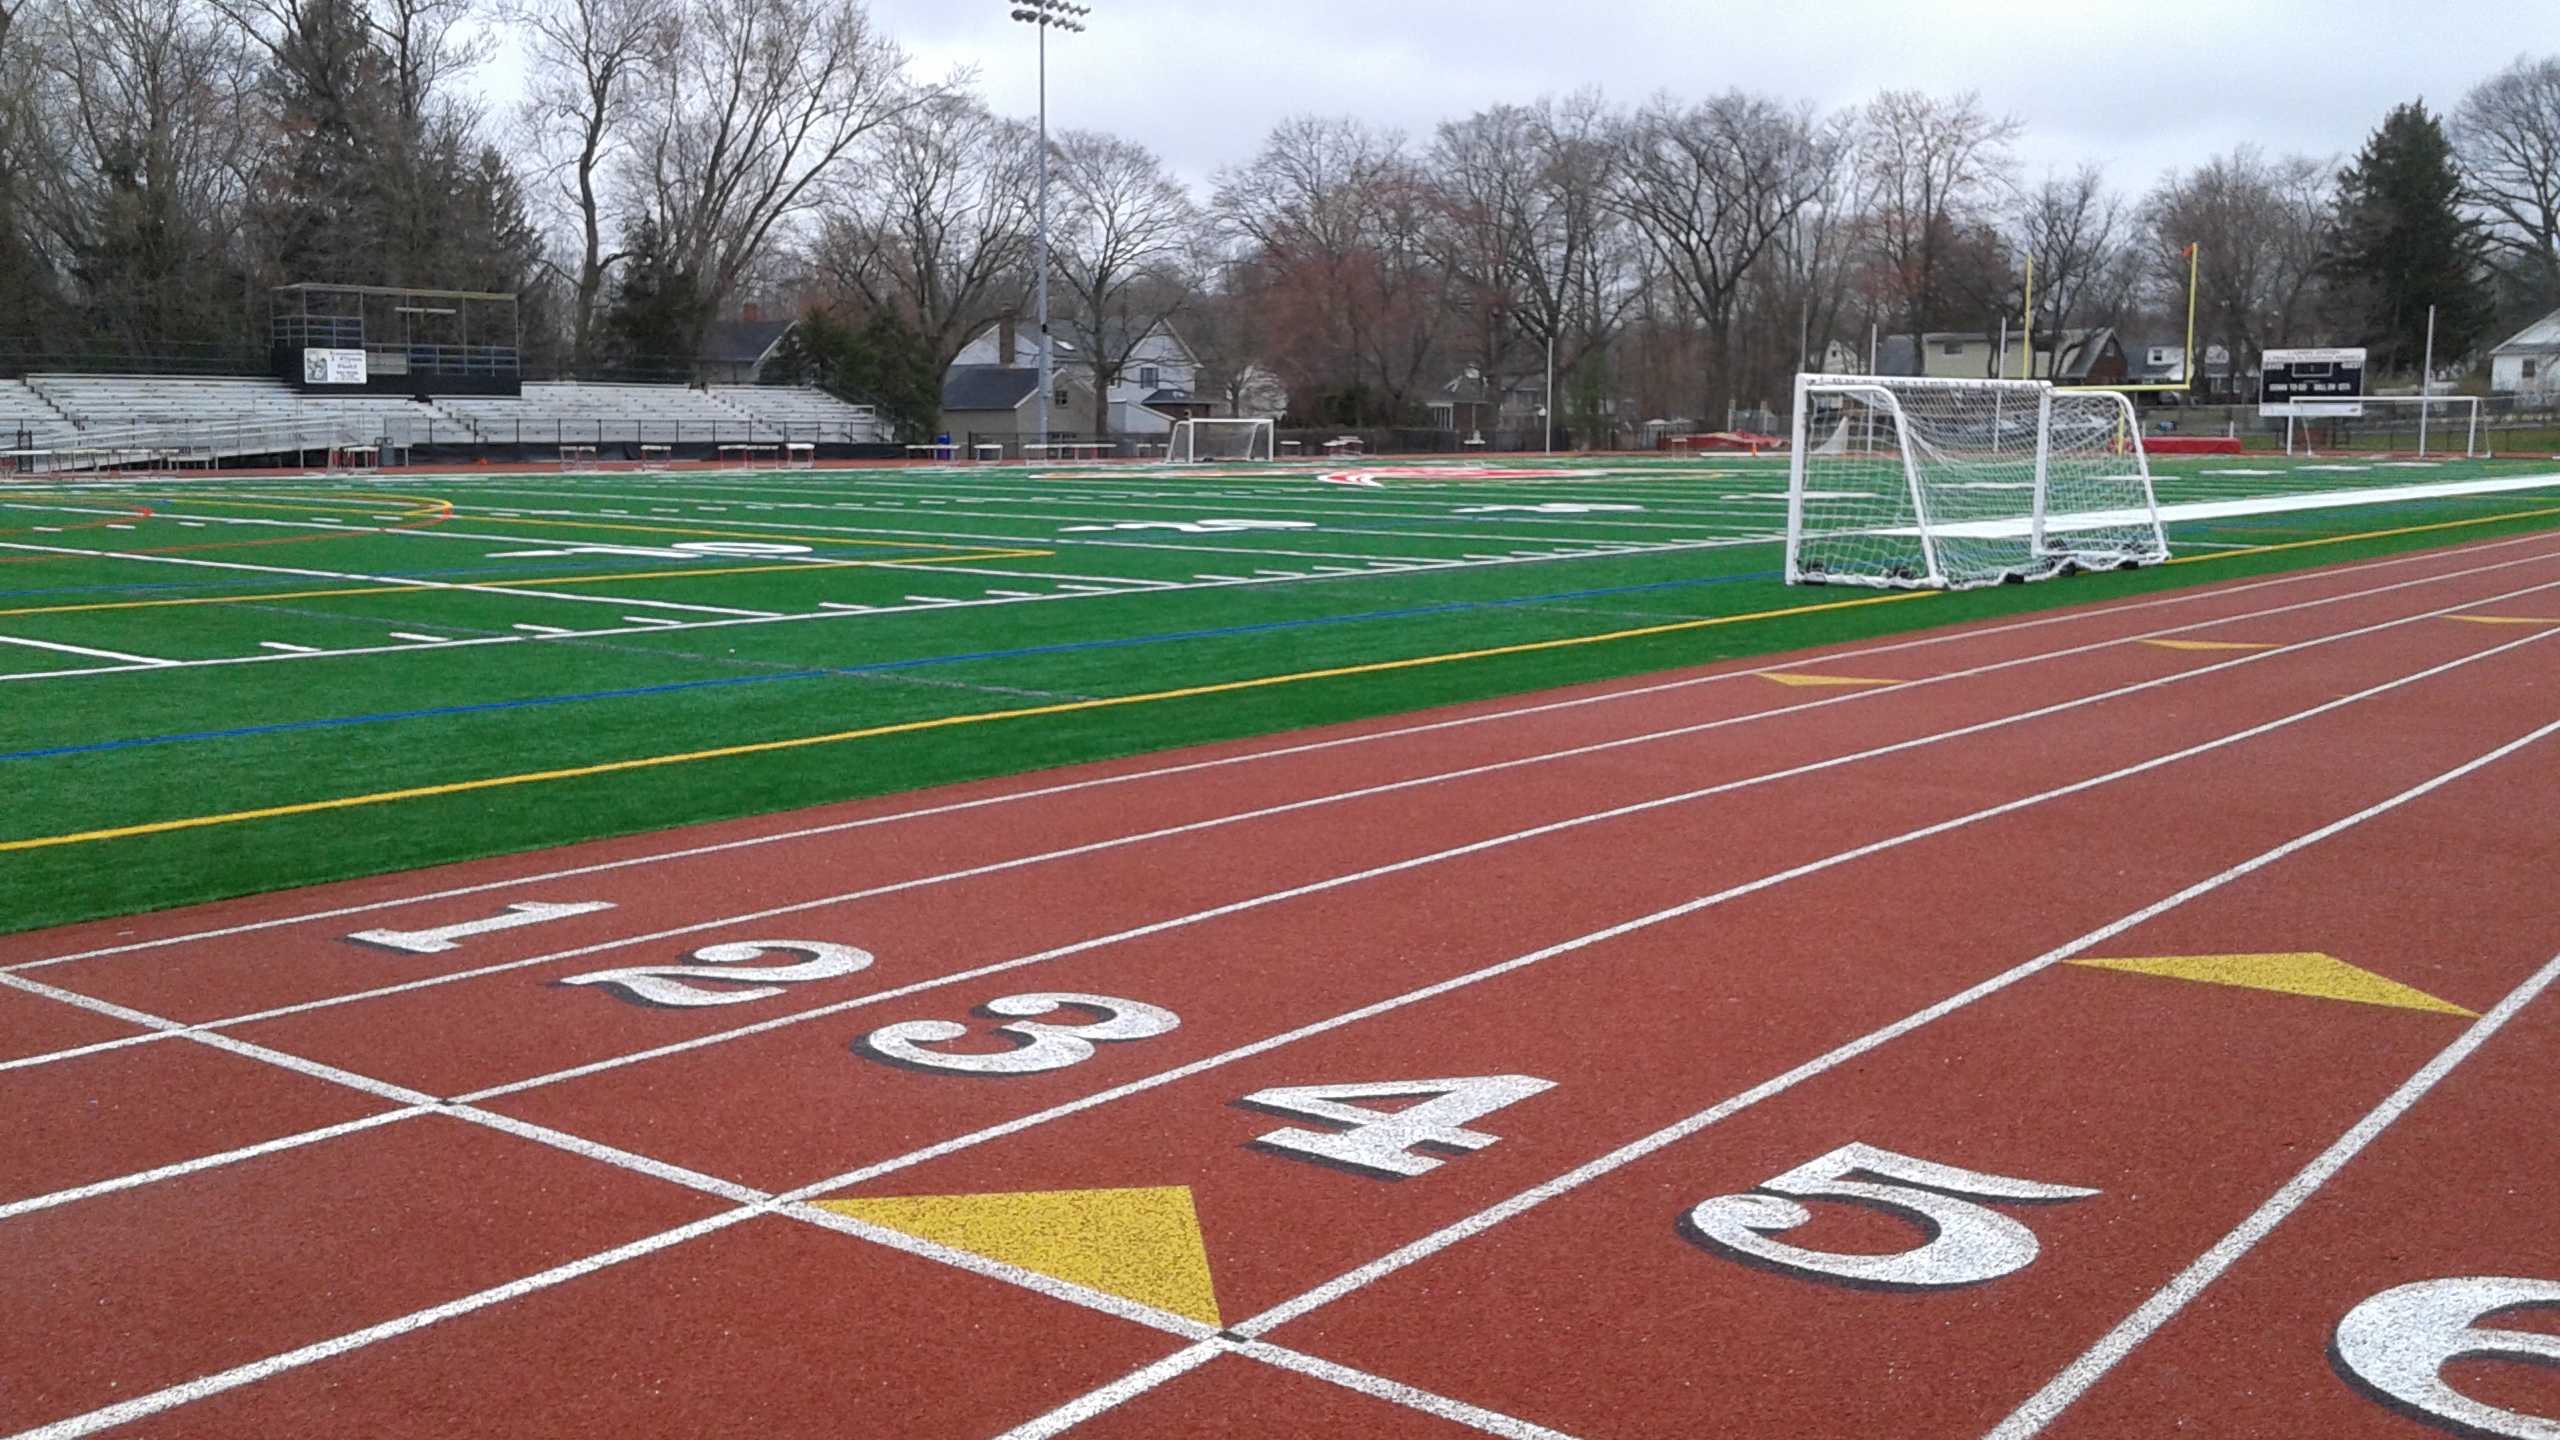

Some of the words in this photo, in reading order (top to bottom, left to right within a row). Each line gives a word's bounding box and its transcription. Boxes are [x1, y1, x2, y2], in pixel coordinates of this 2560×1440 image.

[345, 900, 618, 955] 1
[558, 939, 876, 1008] 2
[862, 992, 1181, 1077] 3
[1243, 1074, 1559, 1177] 4
[1685, 1141, 2103, 1287] 5
